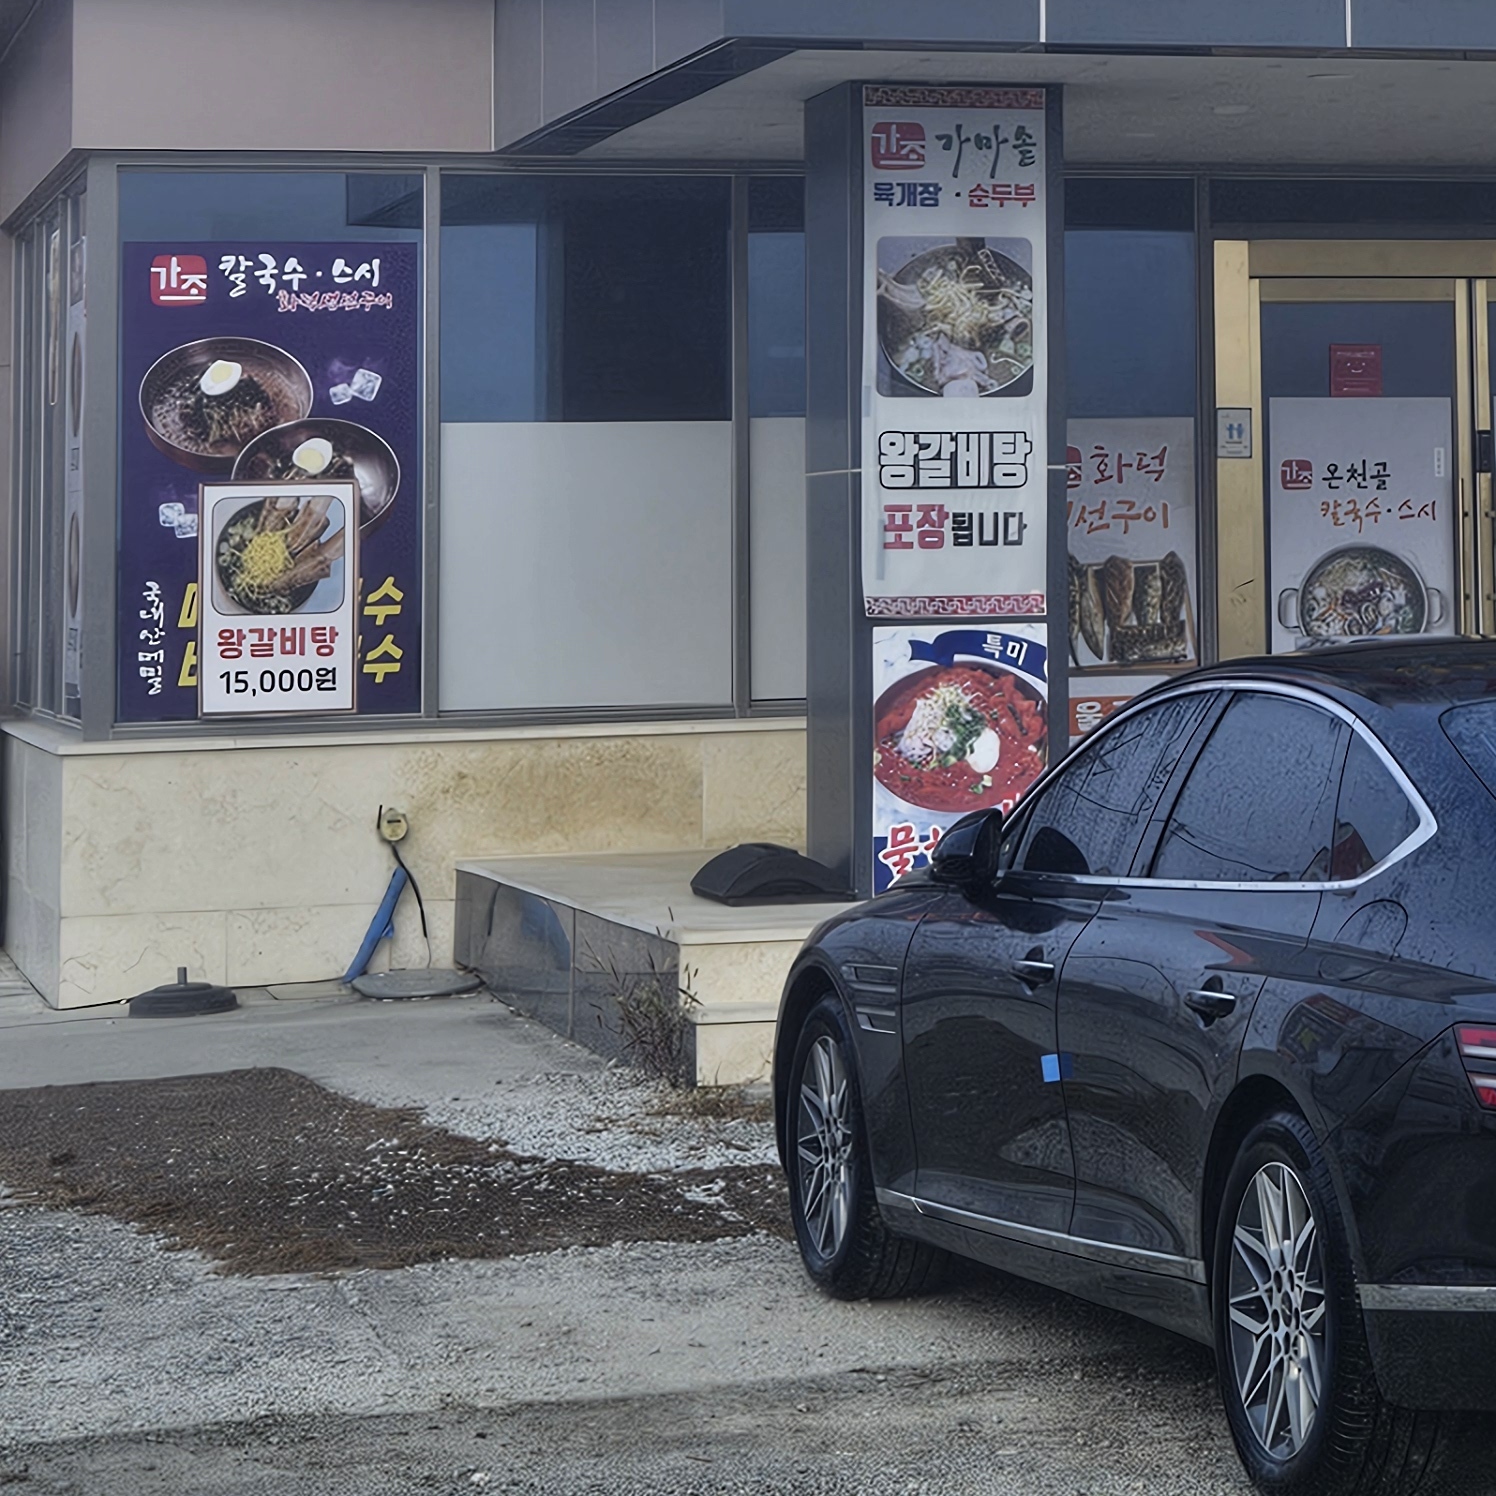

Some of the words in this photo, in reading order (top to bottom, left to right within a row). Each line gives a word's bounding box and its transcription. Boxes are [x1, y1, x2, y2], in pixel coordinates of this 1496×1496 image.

[150, 256, 208, 301] 가조
[878, 430, 1033, 490] 왕갈비탕
[1089, 445, 1168, 485] 화덕
[1321, 458, 1391, 491] 온천골
[1067, 500, 1169, 535] 선구이
[216, 625, 339, 660] 왕갈비탕
[982, 633, 1028, 666] 특미
[218, 666, 338, 697] 15,000원
